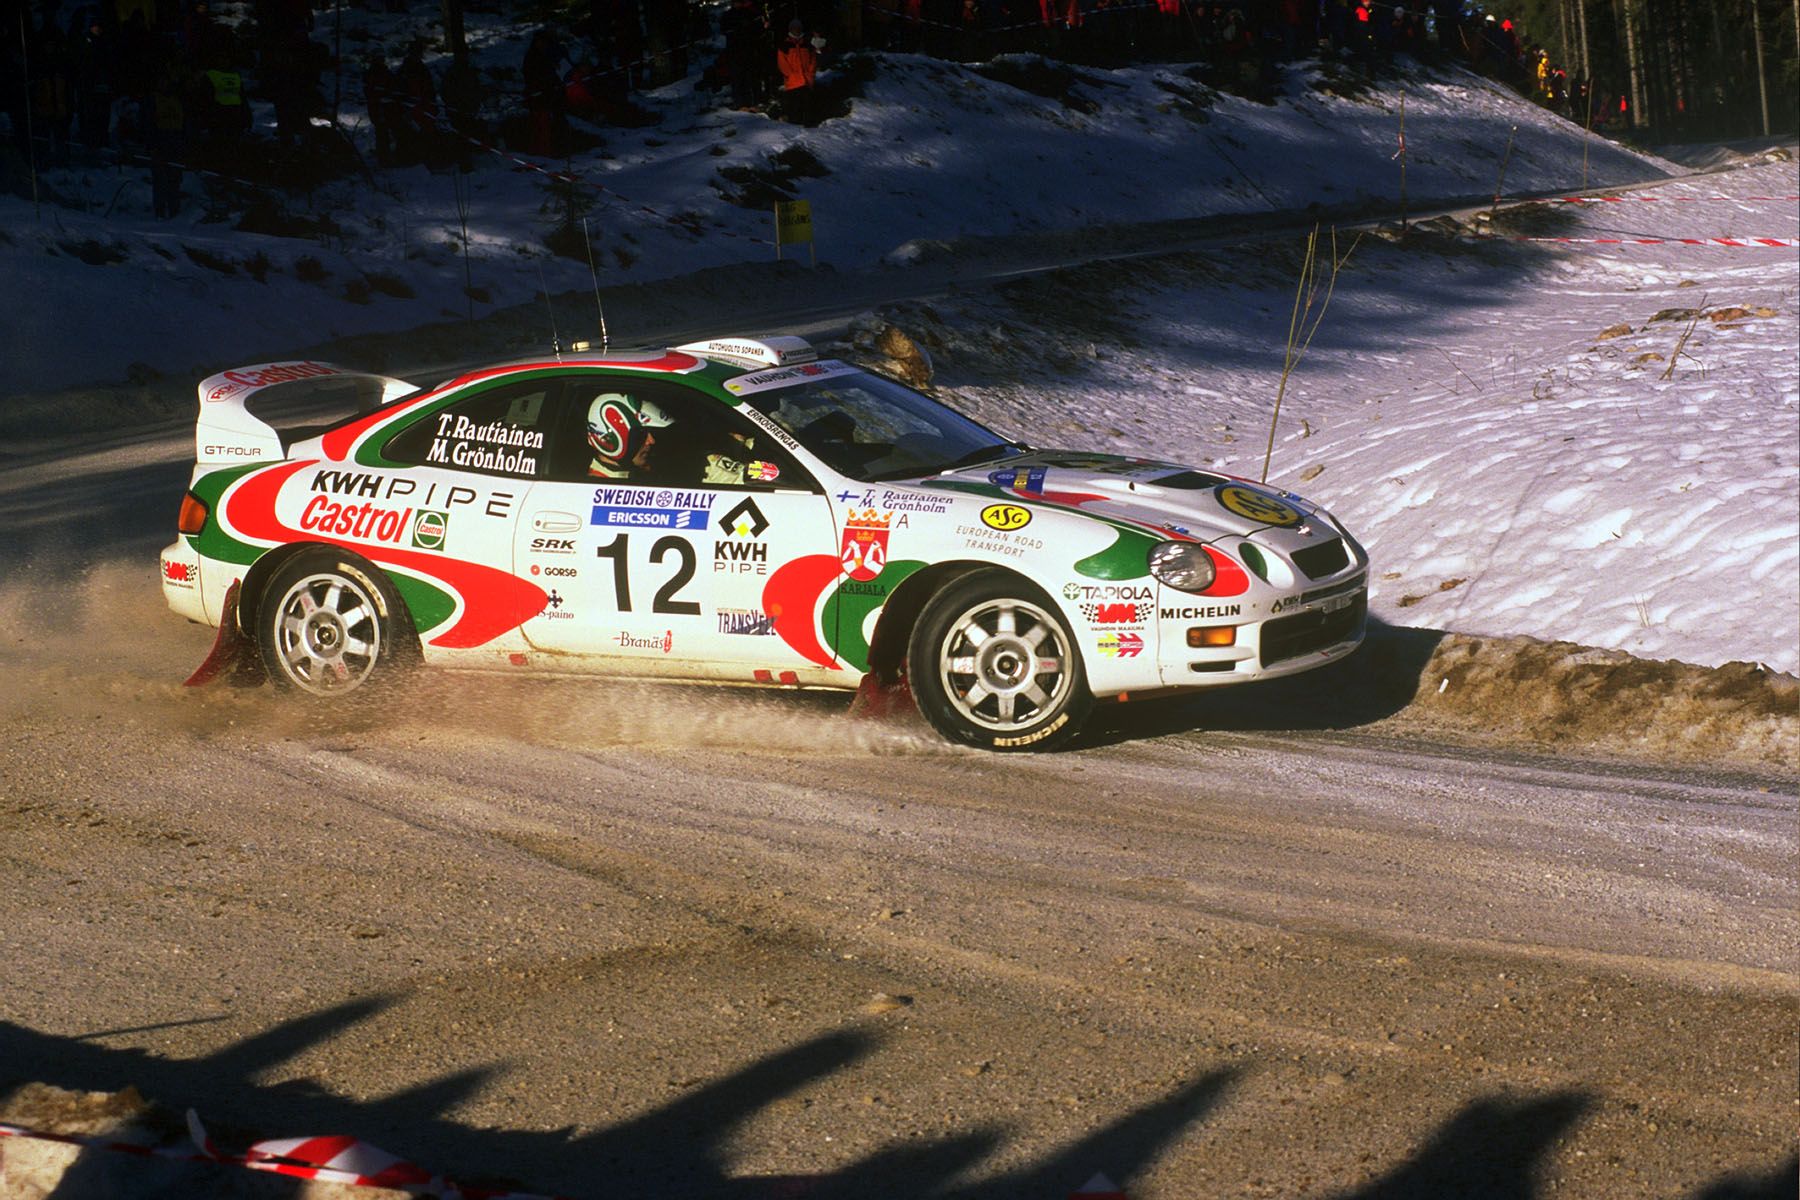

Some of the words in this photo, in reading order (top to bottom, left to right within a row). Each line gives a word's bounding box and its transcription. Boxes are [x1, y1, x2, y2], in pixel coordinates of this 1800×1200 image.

[223, 360, 342, 387] Castrol
[746, 409, 800, 450] ERIKOISRENGAS
[426, 438, 449, 464] M.
[452, 441, 536, 475] Grönholm
[311, 470, 382, 499] KWH
[385, 478, 515, 518] PIPE
[593, 488, 654, 508] SWEDISH
[673, 494, 717, 510] RALLY
[883, 490, 954, 505] Rautiainen
[882, 499, 947, 514] Grönholm
[988, 506, 1024, 527] ASG
[300, 495, 413, 543] Castrol
[608, 511, 669, 526] ERICSSON
[896, 513, 910, 529] A
[419, 524, 444, 536] Castrol
[956, 525, 1009, 542] EUROPEAN
[1014, 535, 1044, 550] ROAD
[531, 538, 577, 550] SRK
[714, 540, 768, 562] KWH
[965, 539, 1025, 558] TRANSPORT
[596, 532, 702, 616] 12
[714, 562, 768, 576] PIPE
[1081, 586, 1154, 600] TAPIOLA
[1160, 605, 1241, 620] MICHELIN
[993, 712, 1070, 747] MICHELIN
